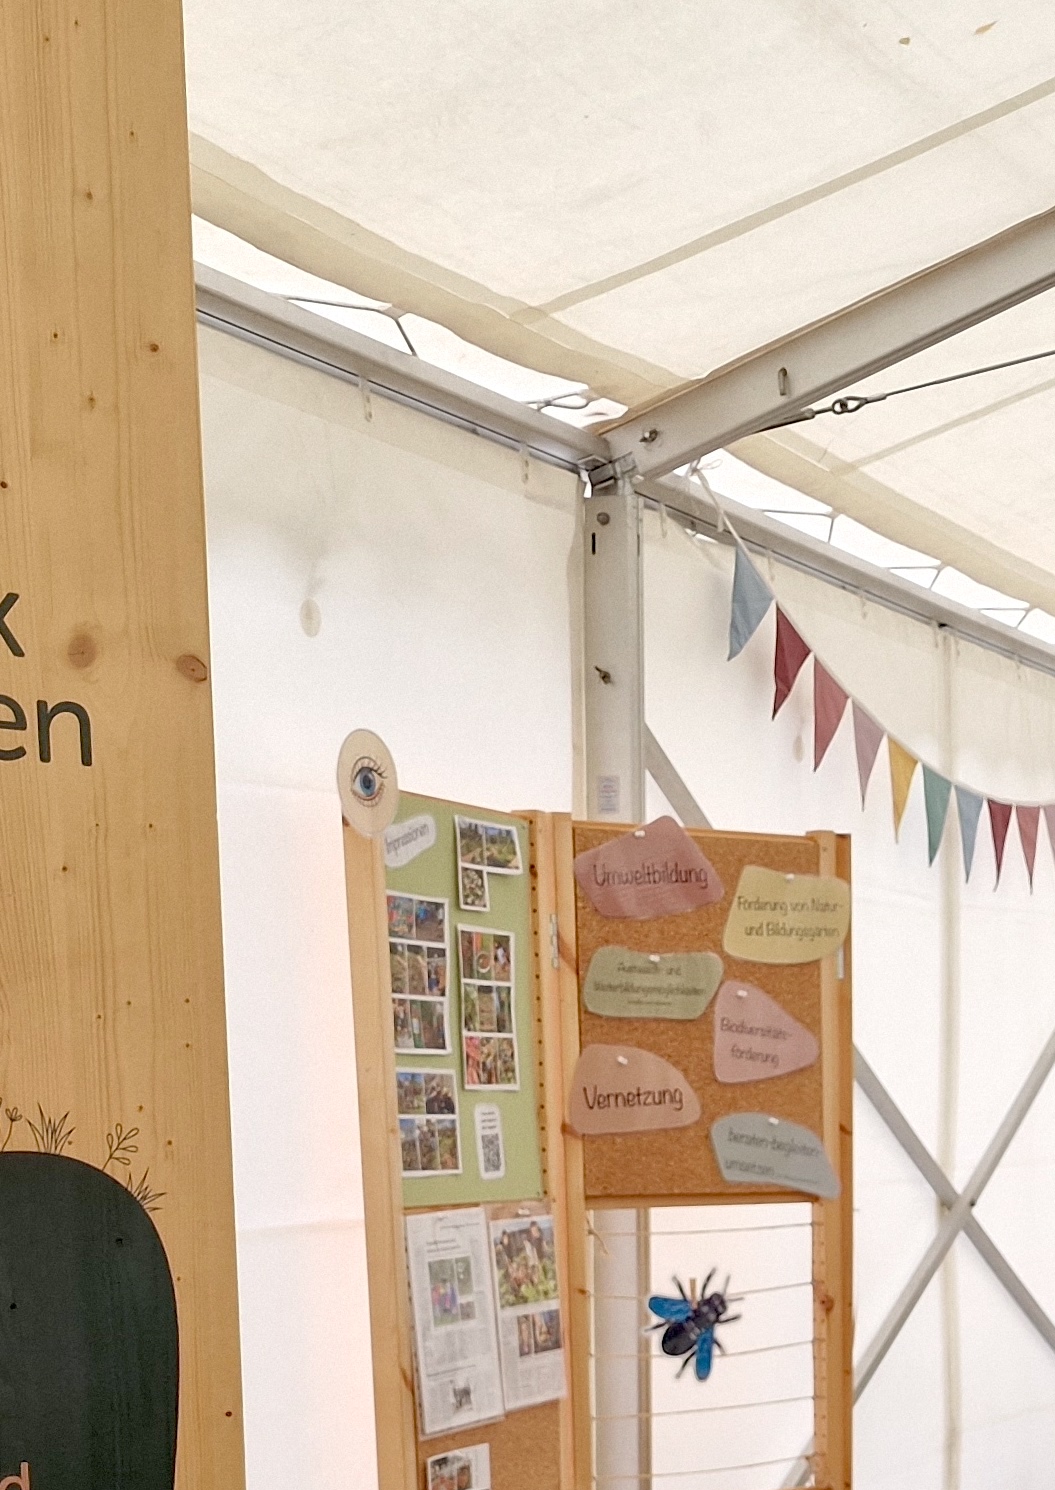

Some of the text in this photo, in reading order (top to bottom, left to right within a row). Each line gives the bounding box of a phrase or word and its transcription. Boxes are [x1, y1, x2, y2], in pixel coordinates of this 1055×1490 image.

[593, 861, 709, 889] Umweltbildung
[744, 922, 763, 936] und
[583, 1085, 684, 1111] Vernetzung
